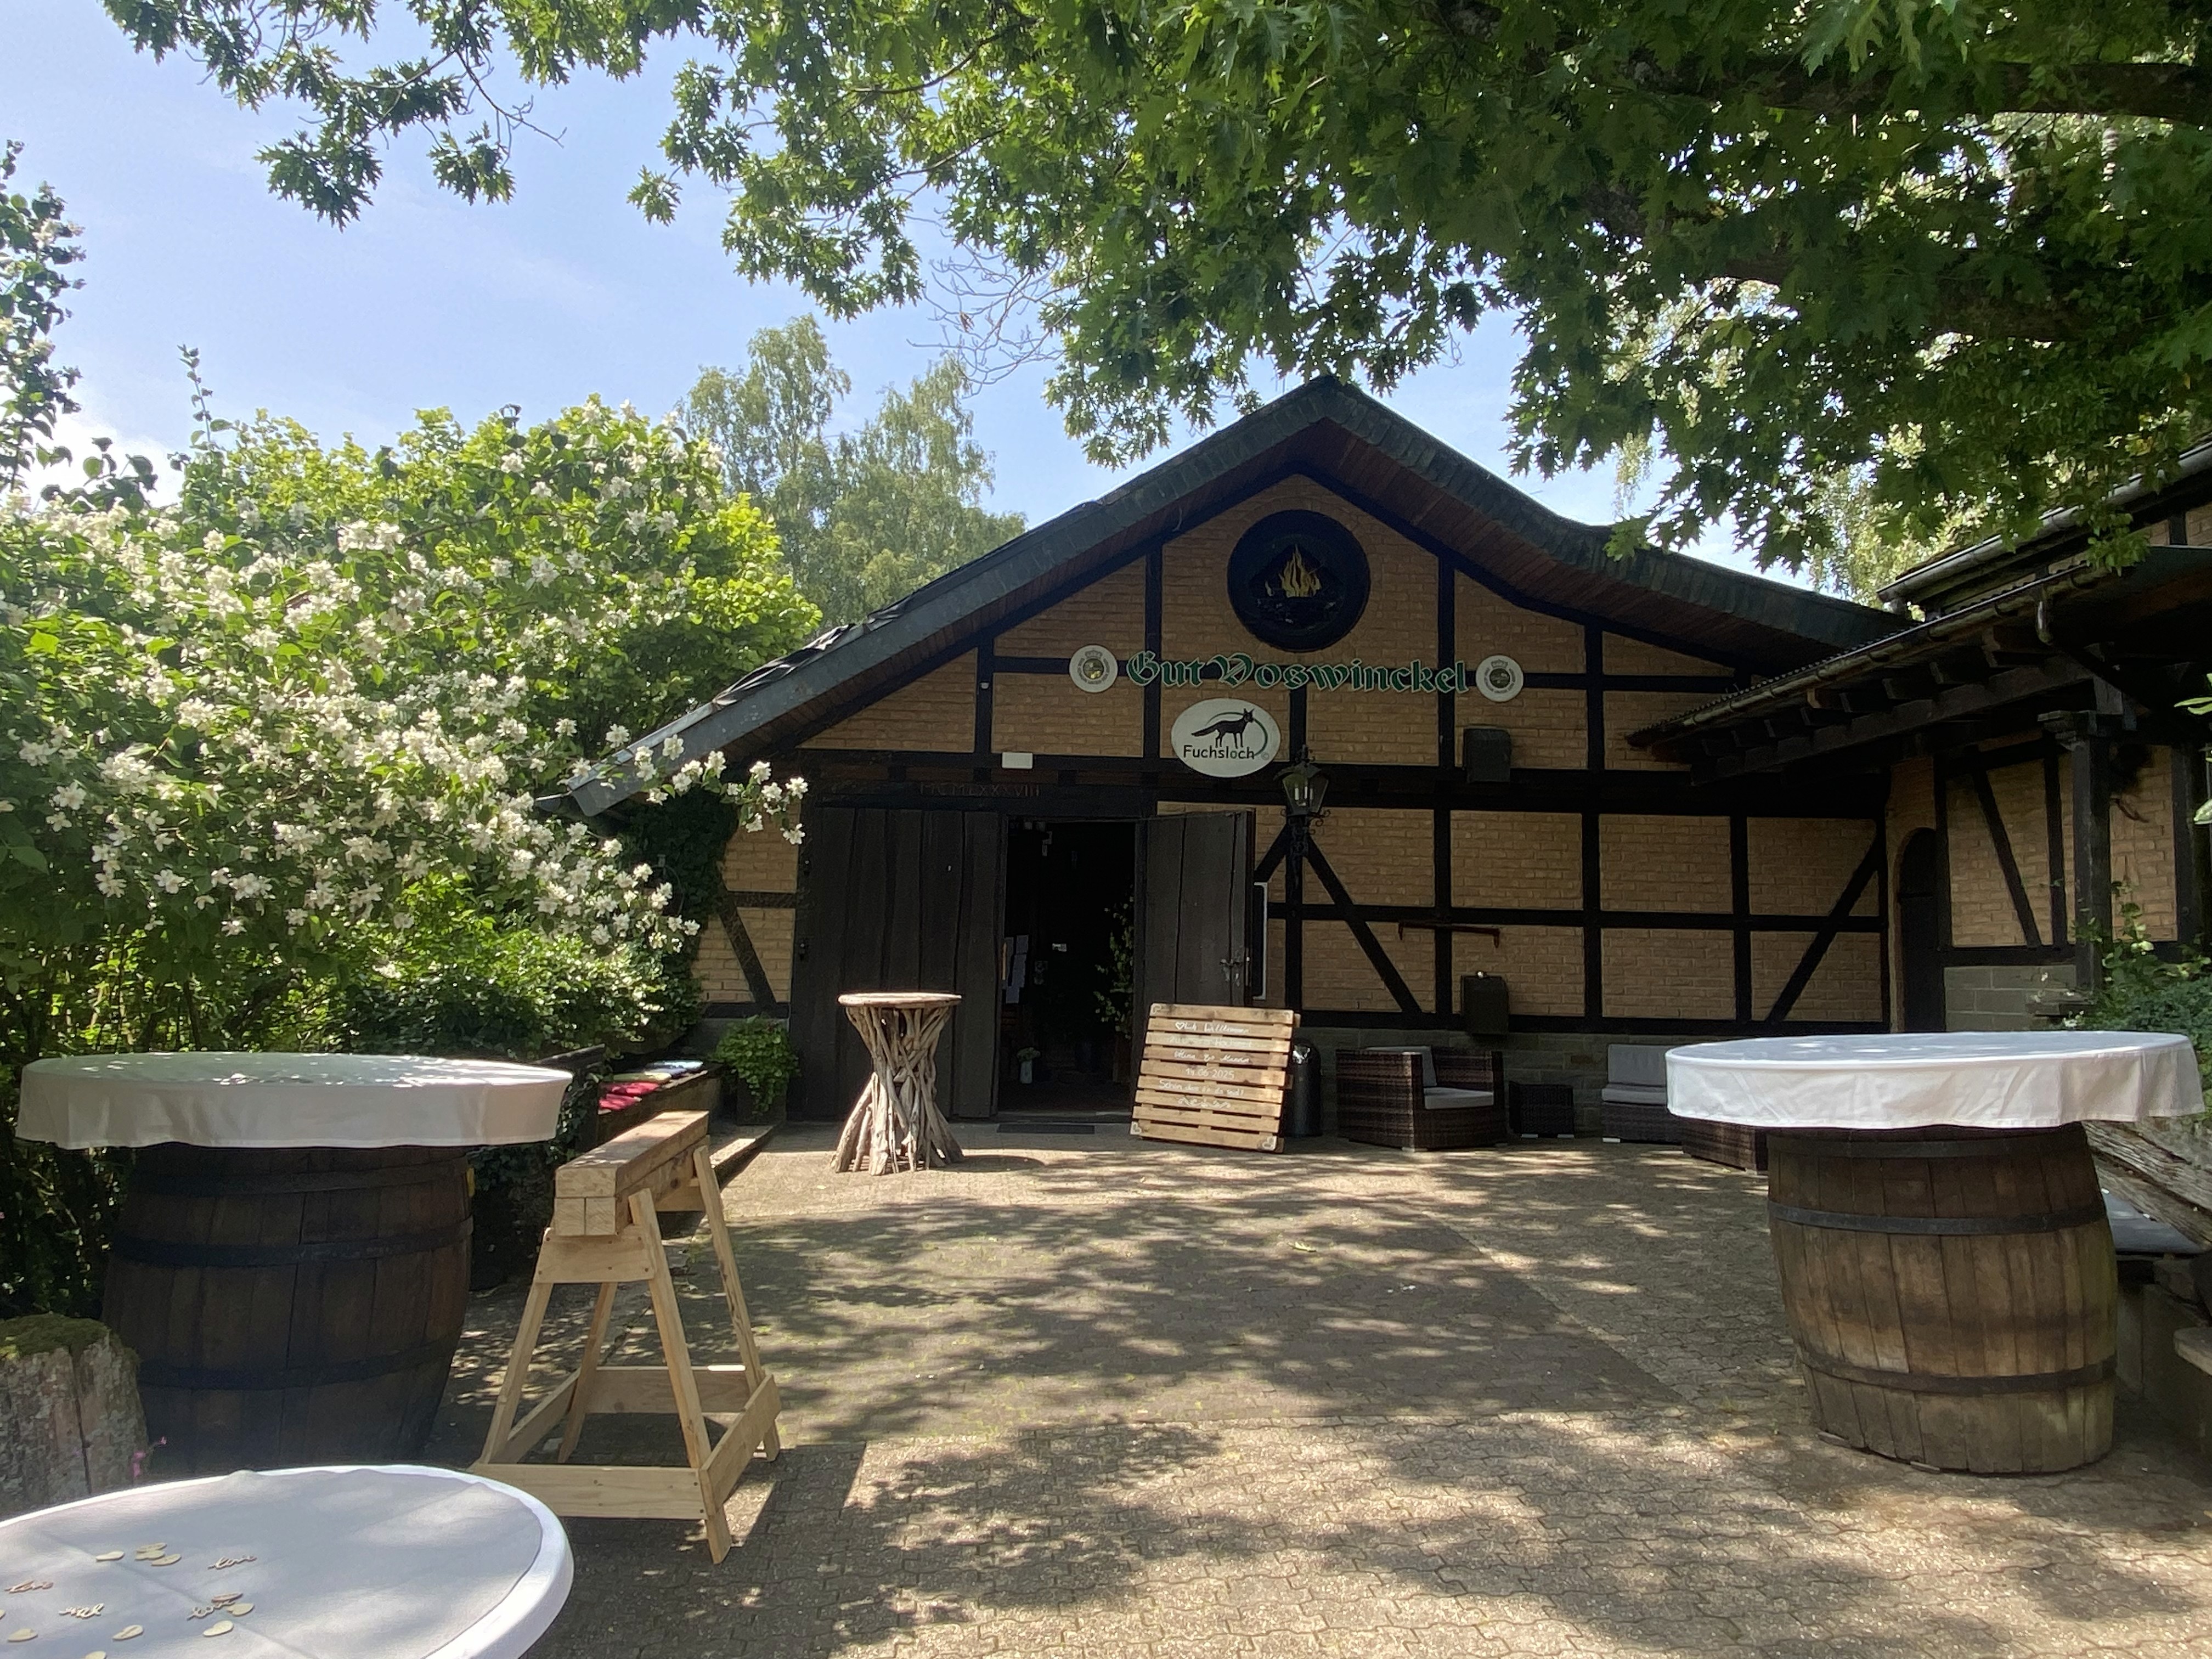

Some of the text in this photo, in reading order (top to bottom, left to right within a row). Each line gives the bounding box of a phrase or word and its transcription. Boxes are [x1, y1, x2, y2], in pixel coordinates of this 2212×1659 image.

[1126, 651, 1205, 686] Gut
[1207, 652, 1469, 693] Voswinckel
[1183, 744, 1255, 760] Fuchsloch
